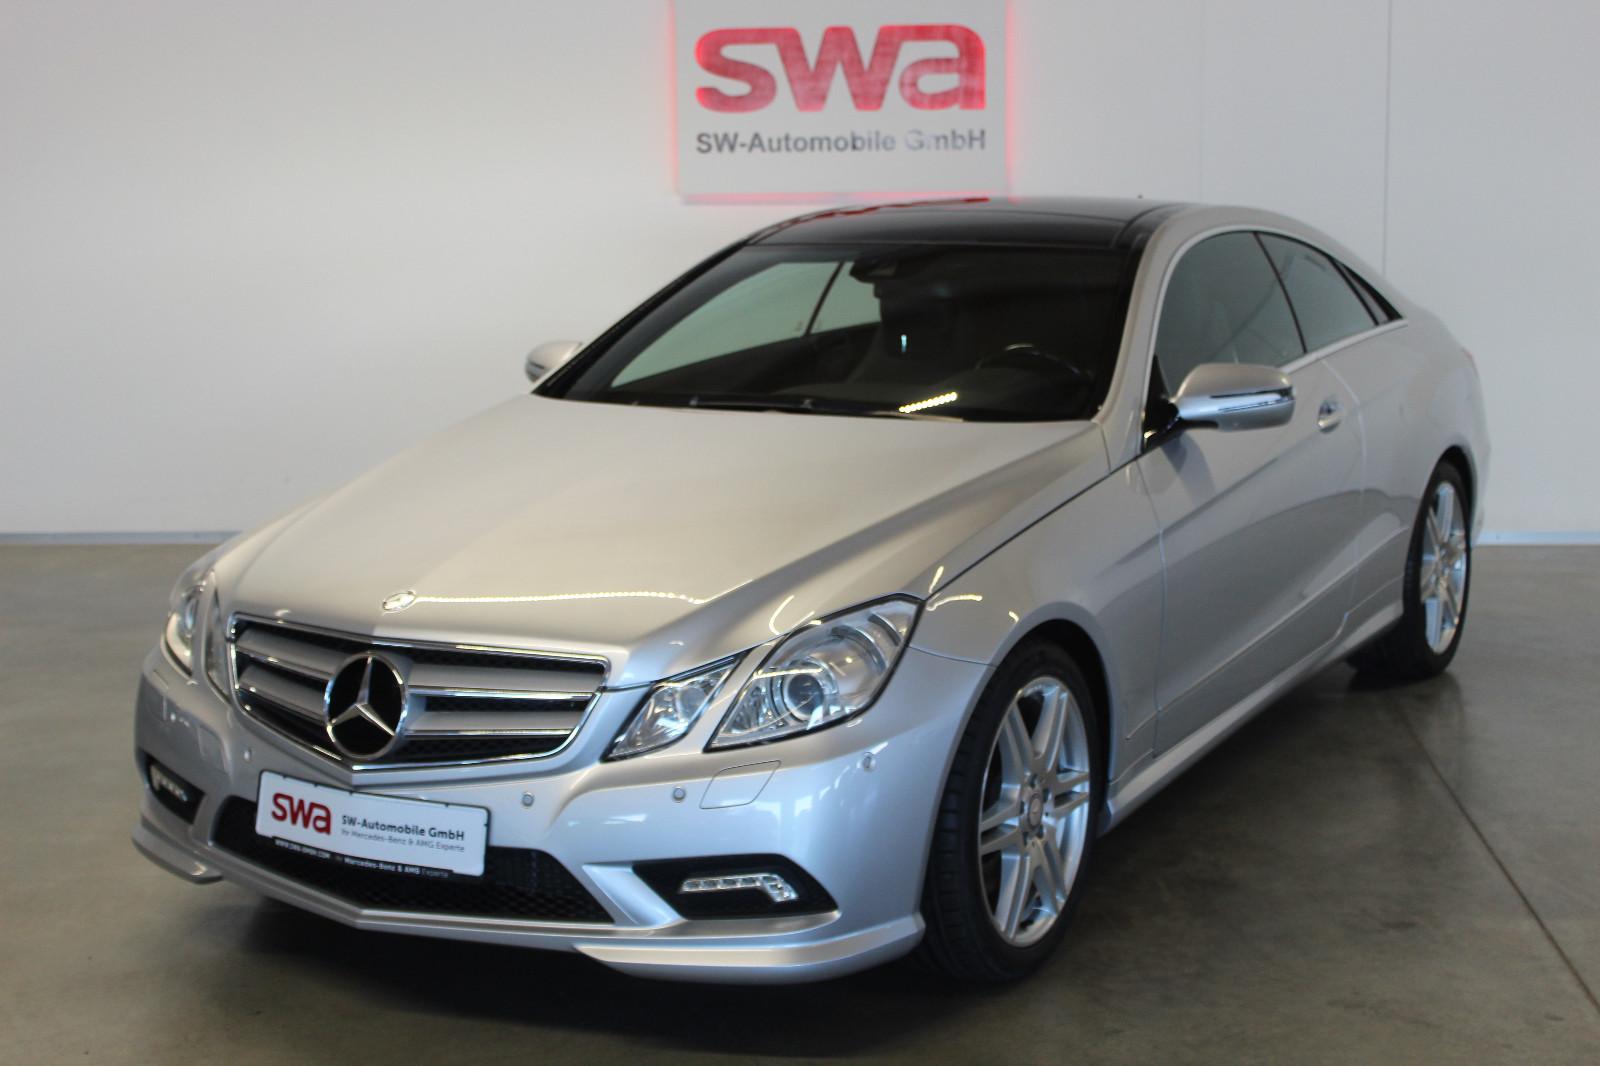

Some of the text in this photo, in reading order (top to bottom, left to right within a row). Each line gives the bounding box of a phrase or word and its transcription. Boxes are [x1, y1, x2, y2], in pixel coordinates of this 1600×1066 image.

[696, 129, 986, 154] SW-Automobile GmbH
[341, 814, 465, 841] SW-Automobile GmbH
[416, 839, 435, 849] AMG
